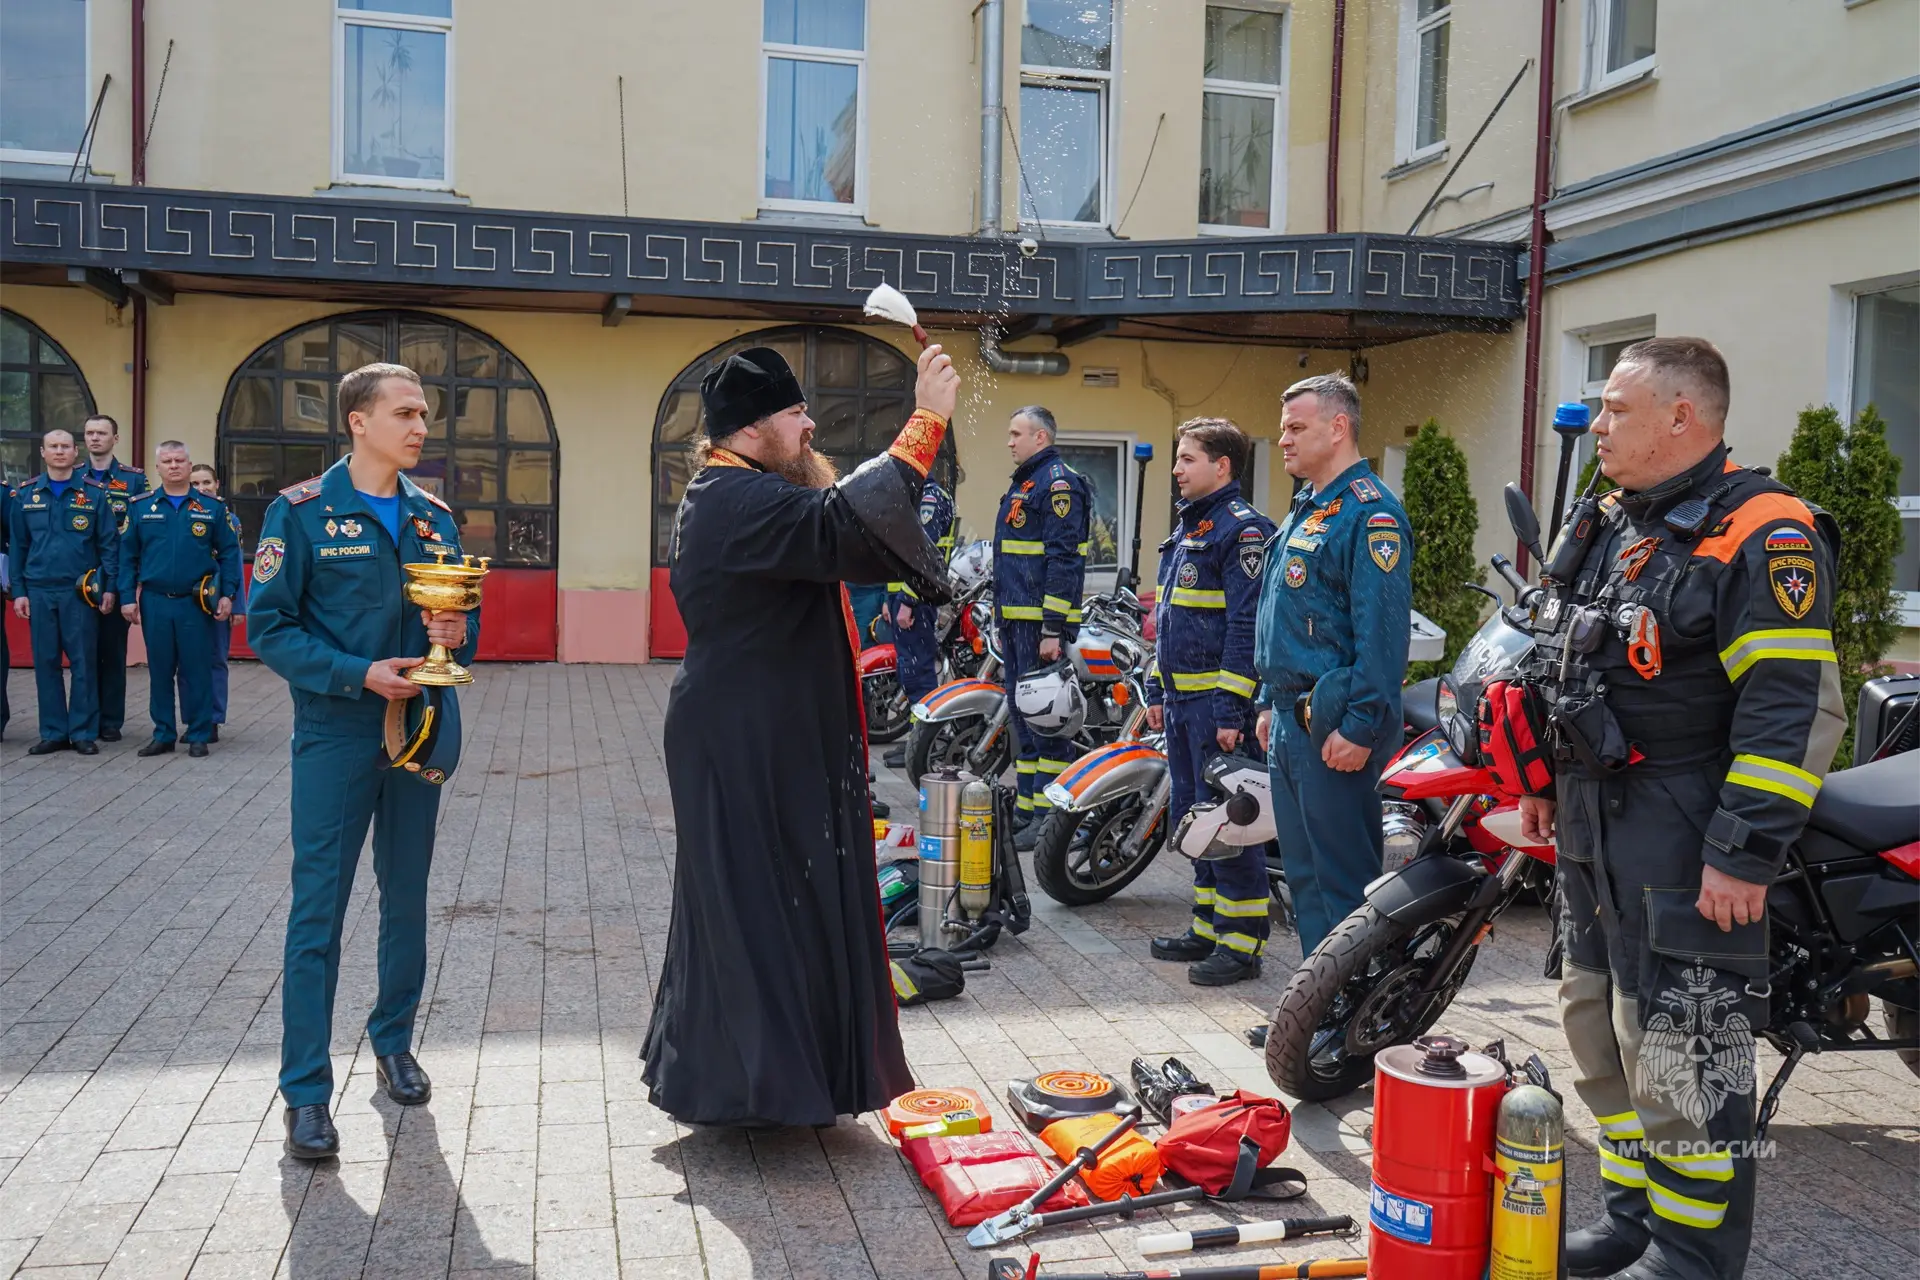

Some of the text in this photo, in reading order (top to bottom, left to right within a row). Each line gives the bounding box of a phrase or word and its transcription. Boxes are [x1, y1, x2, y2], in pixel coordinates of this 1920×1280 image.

[320, 545, 371, 557] МЧС РОССИИ
[1771, 559, 1813, 569] МЧС РОССИИ
[1543, 598, 1561, 620] 58
[1502, 1199, 1547, 1216] ARMOTECH
